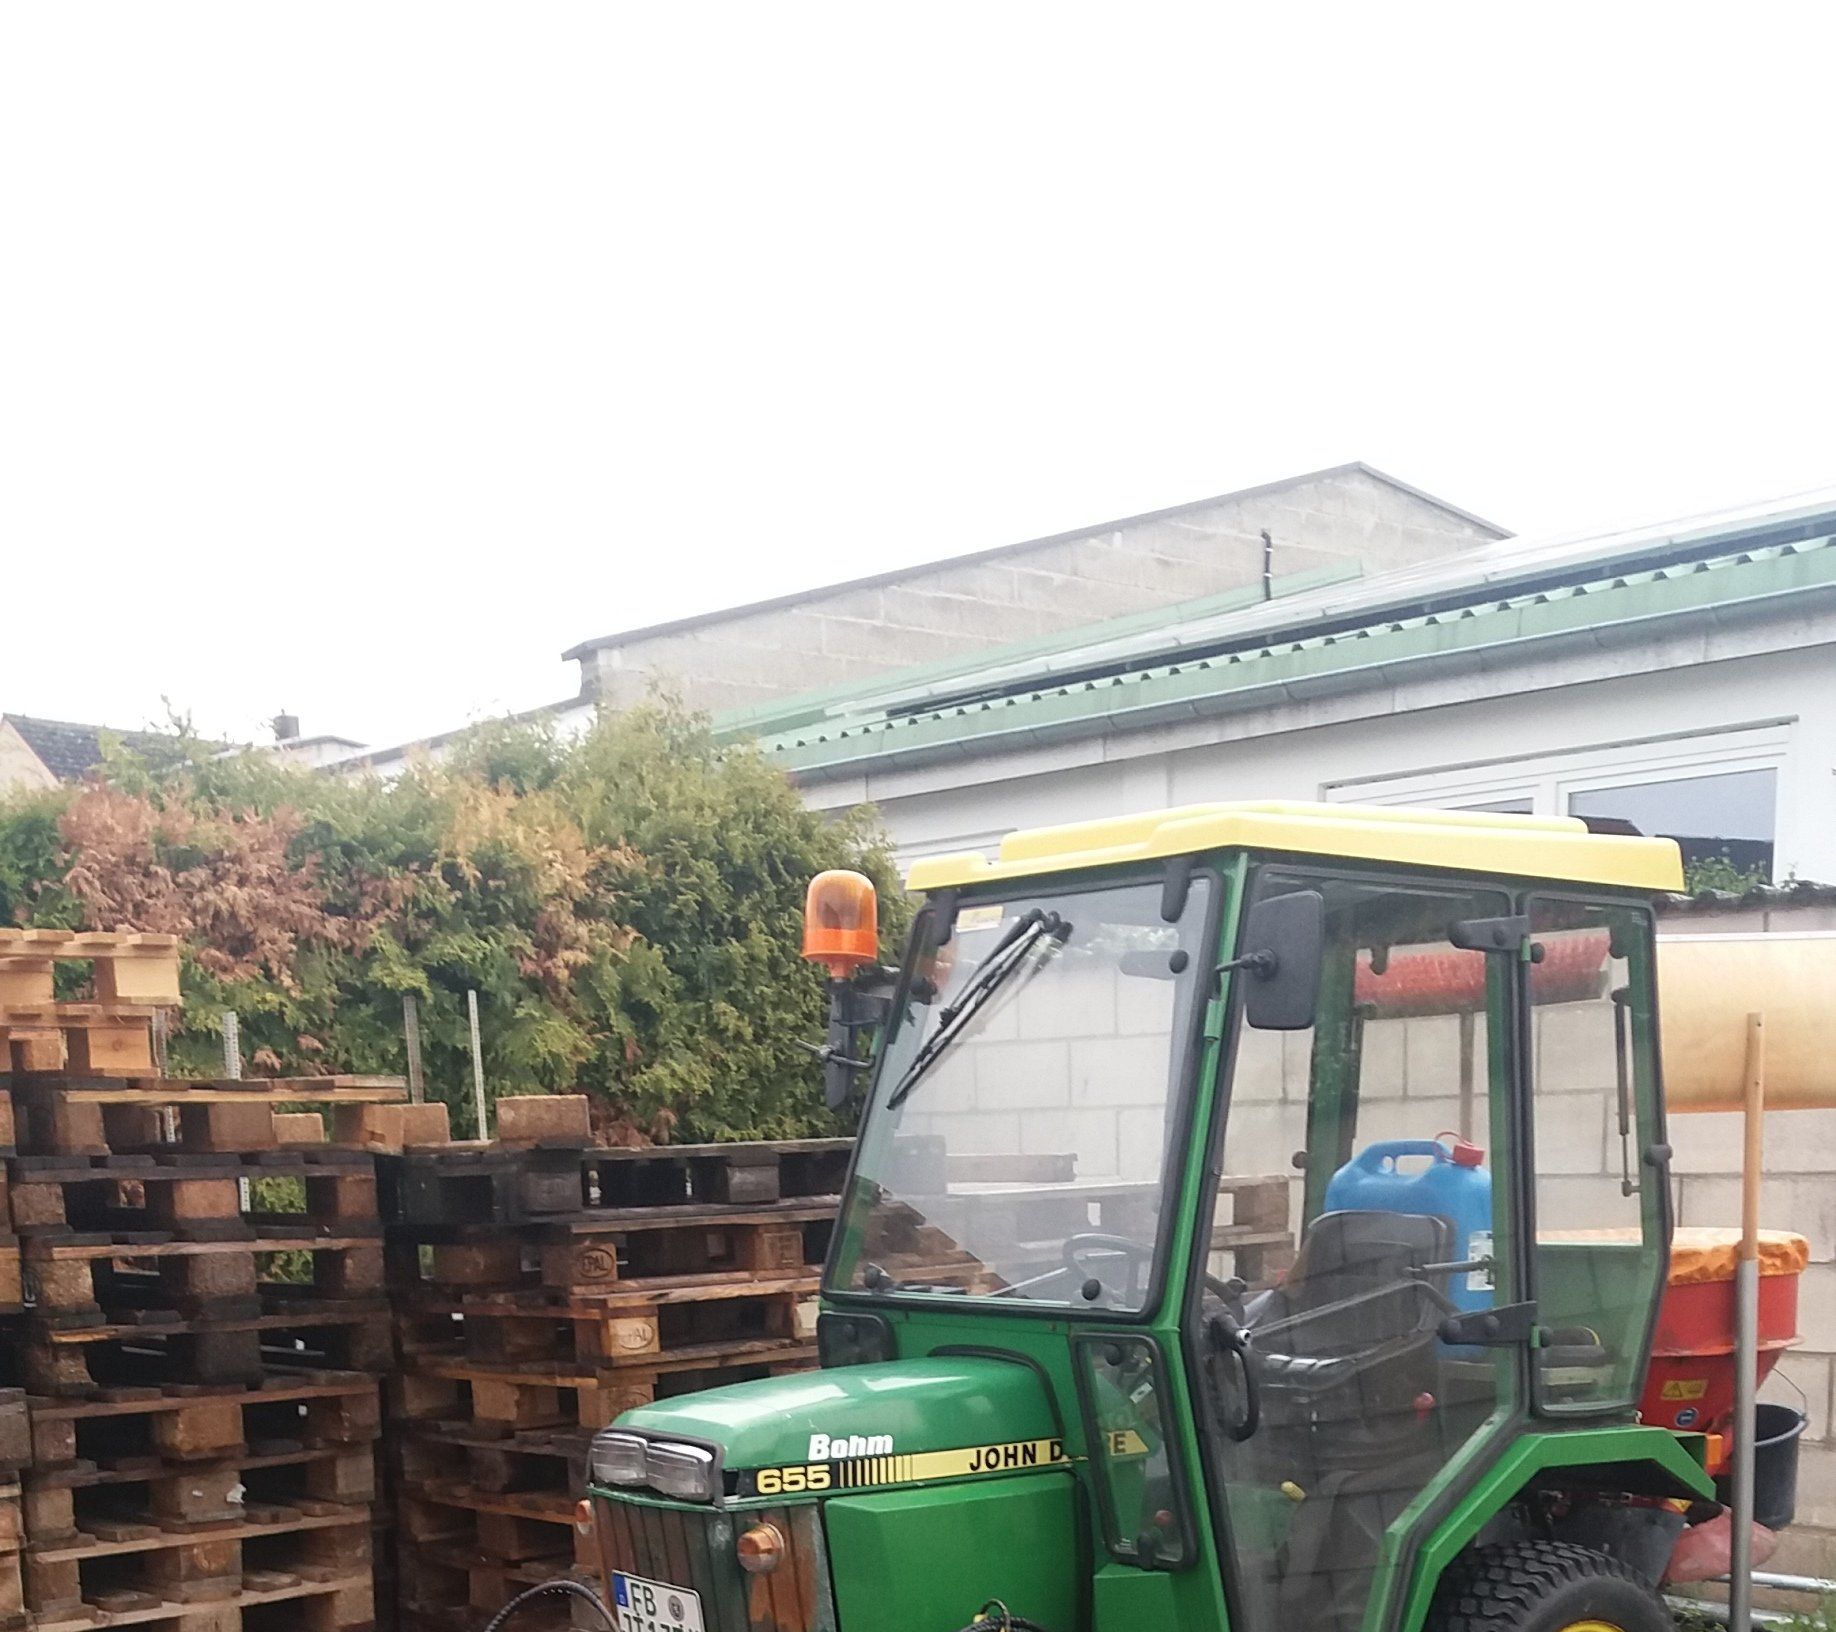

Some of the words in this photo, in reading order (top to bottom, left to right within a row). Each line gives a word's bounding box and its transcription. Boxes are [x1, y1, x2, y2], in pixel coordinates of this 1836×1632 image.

[808, 1433, 893, 1461] Bohm
[969, 1443, 1036, 1471] JOHN
[757, 1464, 831, 1494] 655
[630, 1582, 657, 1616] FB
